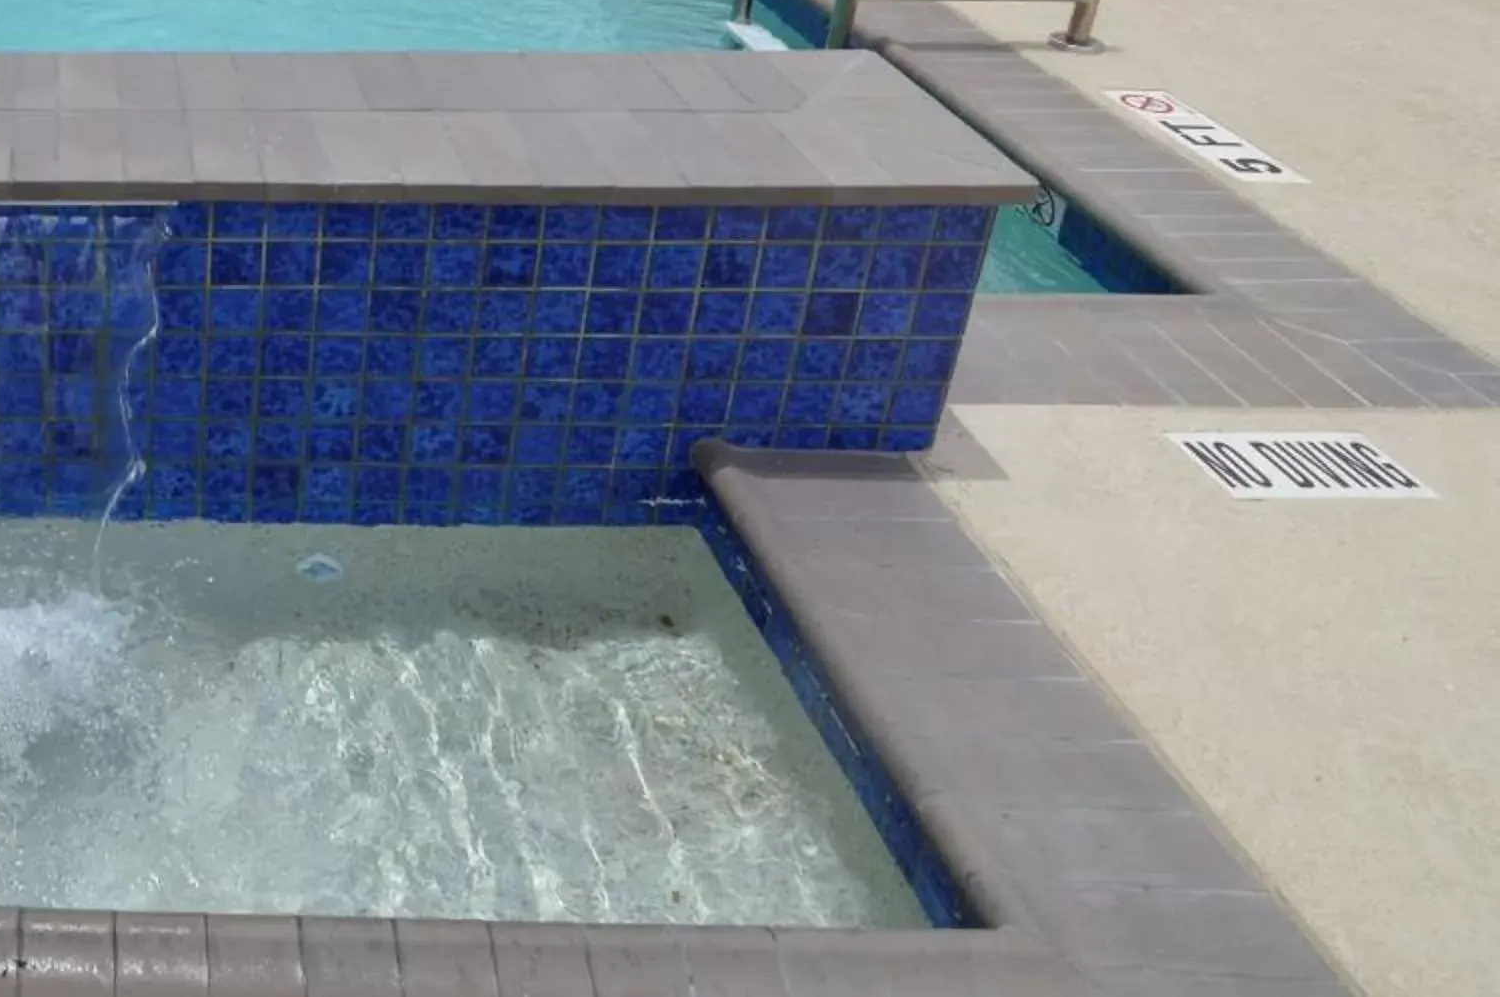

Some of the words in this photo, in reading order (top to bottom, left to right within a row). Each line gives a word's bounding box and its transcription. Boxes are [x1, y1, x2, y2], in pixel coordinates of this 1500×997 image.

[1159, 120, 1243, 147] FT
[1219, 157, 1283, 174] 5
[1183, 441, 1273, 489] NO
[1248, 441, 1421, 489] DIVING
